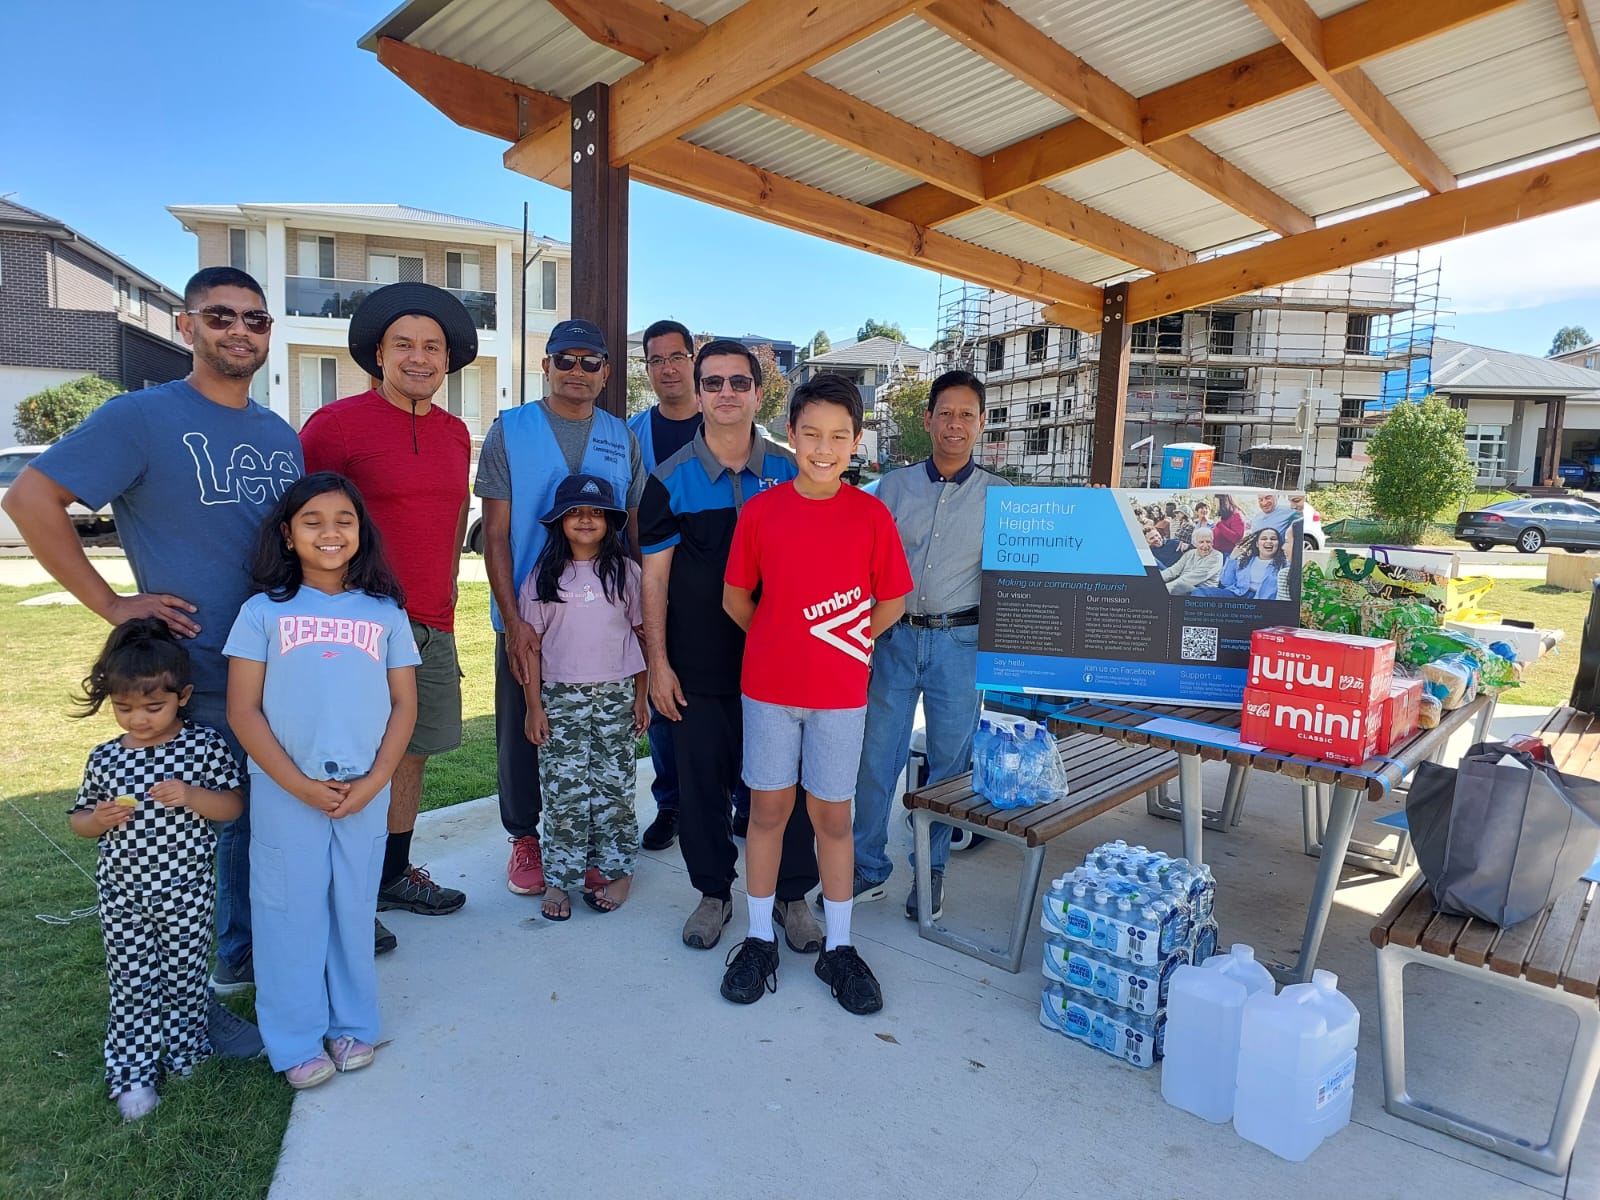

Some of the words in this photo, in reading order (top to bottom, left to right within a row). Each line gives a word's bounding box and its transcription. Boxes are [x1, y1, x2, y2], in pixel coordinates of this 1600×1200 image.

[183, 432, 300, 504] Lee
[1000, 501, 1076, 514] Macarthur
[999, 517, 1055, 533] Heights
[998, 533, 1083, 551] Community
[997, 550, 1040, 566] Group
[997, 578, 1027, 589] Making
[1044, 581, 1093, 592] community
[1094, 582, 1127, 592] flourish
[997, 590, 1009, 598] Our
[1011, 591, 1031, 599] vision
[1086, 595, 1099, 603] Our
[1101, 596, 1130, 604] mission
[803, 586, 861, 620] umbro
[1184, 600, 1216, 608] Become
[1224, 602, 1256, 610] member
[279, 616, 384, 662] REEBOK
[993, 657, 1006, 666] Say
[1277, 651, 1311, 660] CLASSIC
[1084, 663, 1098, 672] Join
[1120, 666, 1156, 676] Facebook
[1180, 670, 1211, 680] Support
[1251, 655, 1334, 690] mini
[1275, 703, 1362, 741] mini
[1297, 733, 1333, 744] CLASSIC
[1325, 751, 1335, 759] 15
